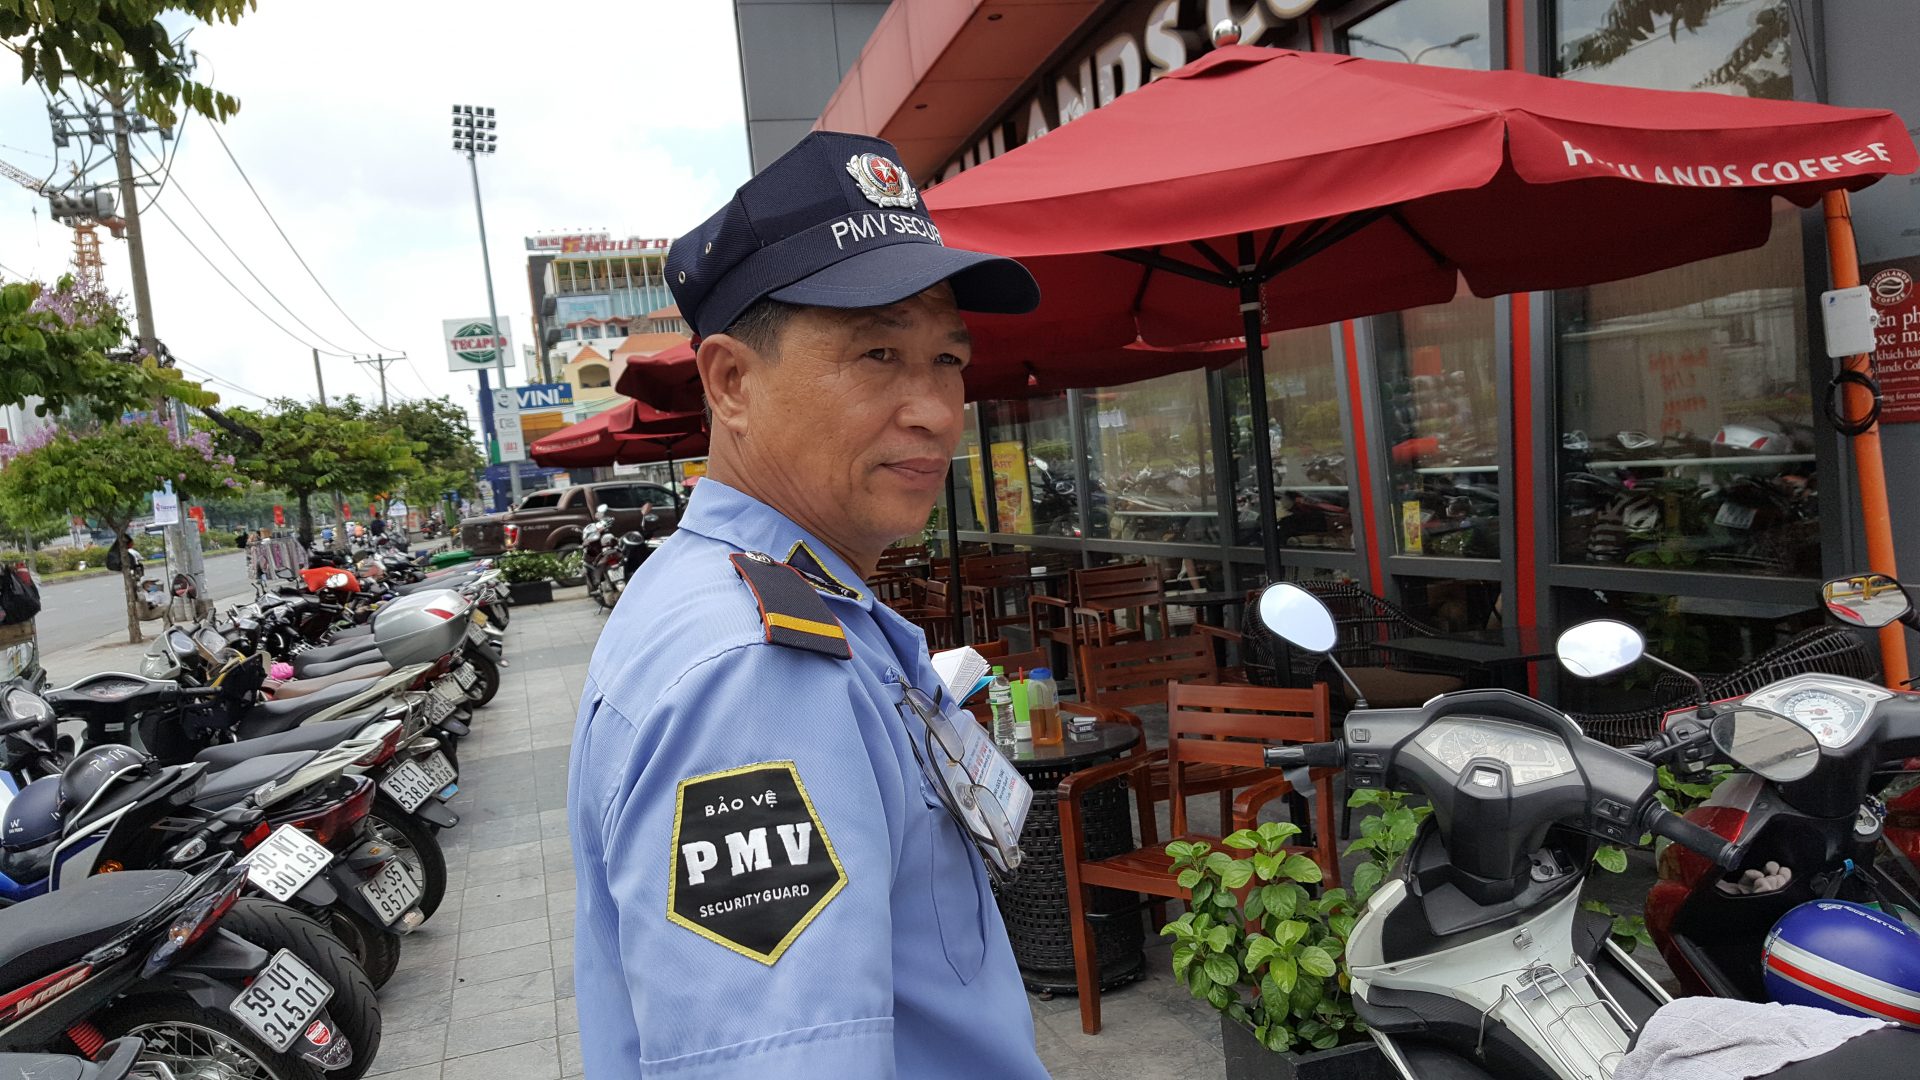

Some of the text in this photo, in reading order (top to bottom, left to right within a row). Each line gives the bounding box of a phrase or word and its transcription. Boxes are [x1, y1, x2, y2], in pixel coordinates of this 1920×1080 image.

[1751, 143, 1892, 184] COFFEE
[831, 213, 887, 250] PMV
[1871, 271, 1910, 289] HIGHLANDS
[1876, 291, 1905, 303] COFFEE
[451, 336, 508, 351] TECAPO
[1877, 348, 1904, 361] khách
[1878, 330, 1920, 346] xe m
[1878, 361, 1902, 373] lands
[516, 388, 560, 408] VINI
[388, 765, 418, 793] 61-C1
[398, 775, 436, 809] 538.04
[704, 789, 778, 817] BẢO VỆ
[250, 834, 299, 876] 50-N1
[266, 844, 326, 896] 301.93
[682, 821, 813, 886] PMV
[369, 865, 403, 900] 54-S5
[381, 883, 415, 917] 9571
[243, 962, 298, 1017] 59-U1
[264, 977, 326, 1044] 345.01
